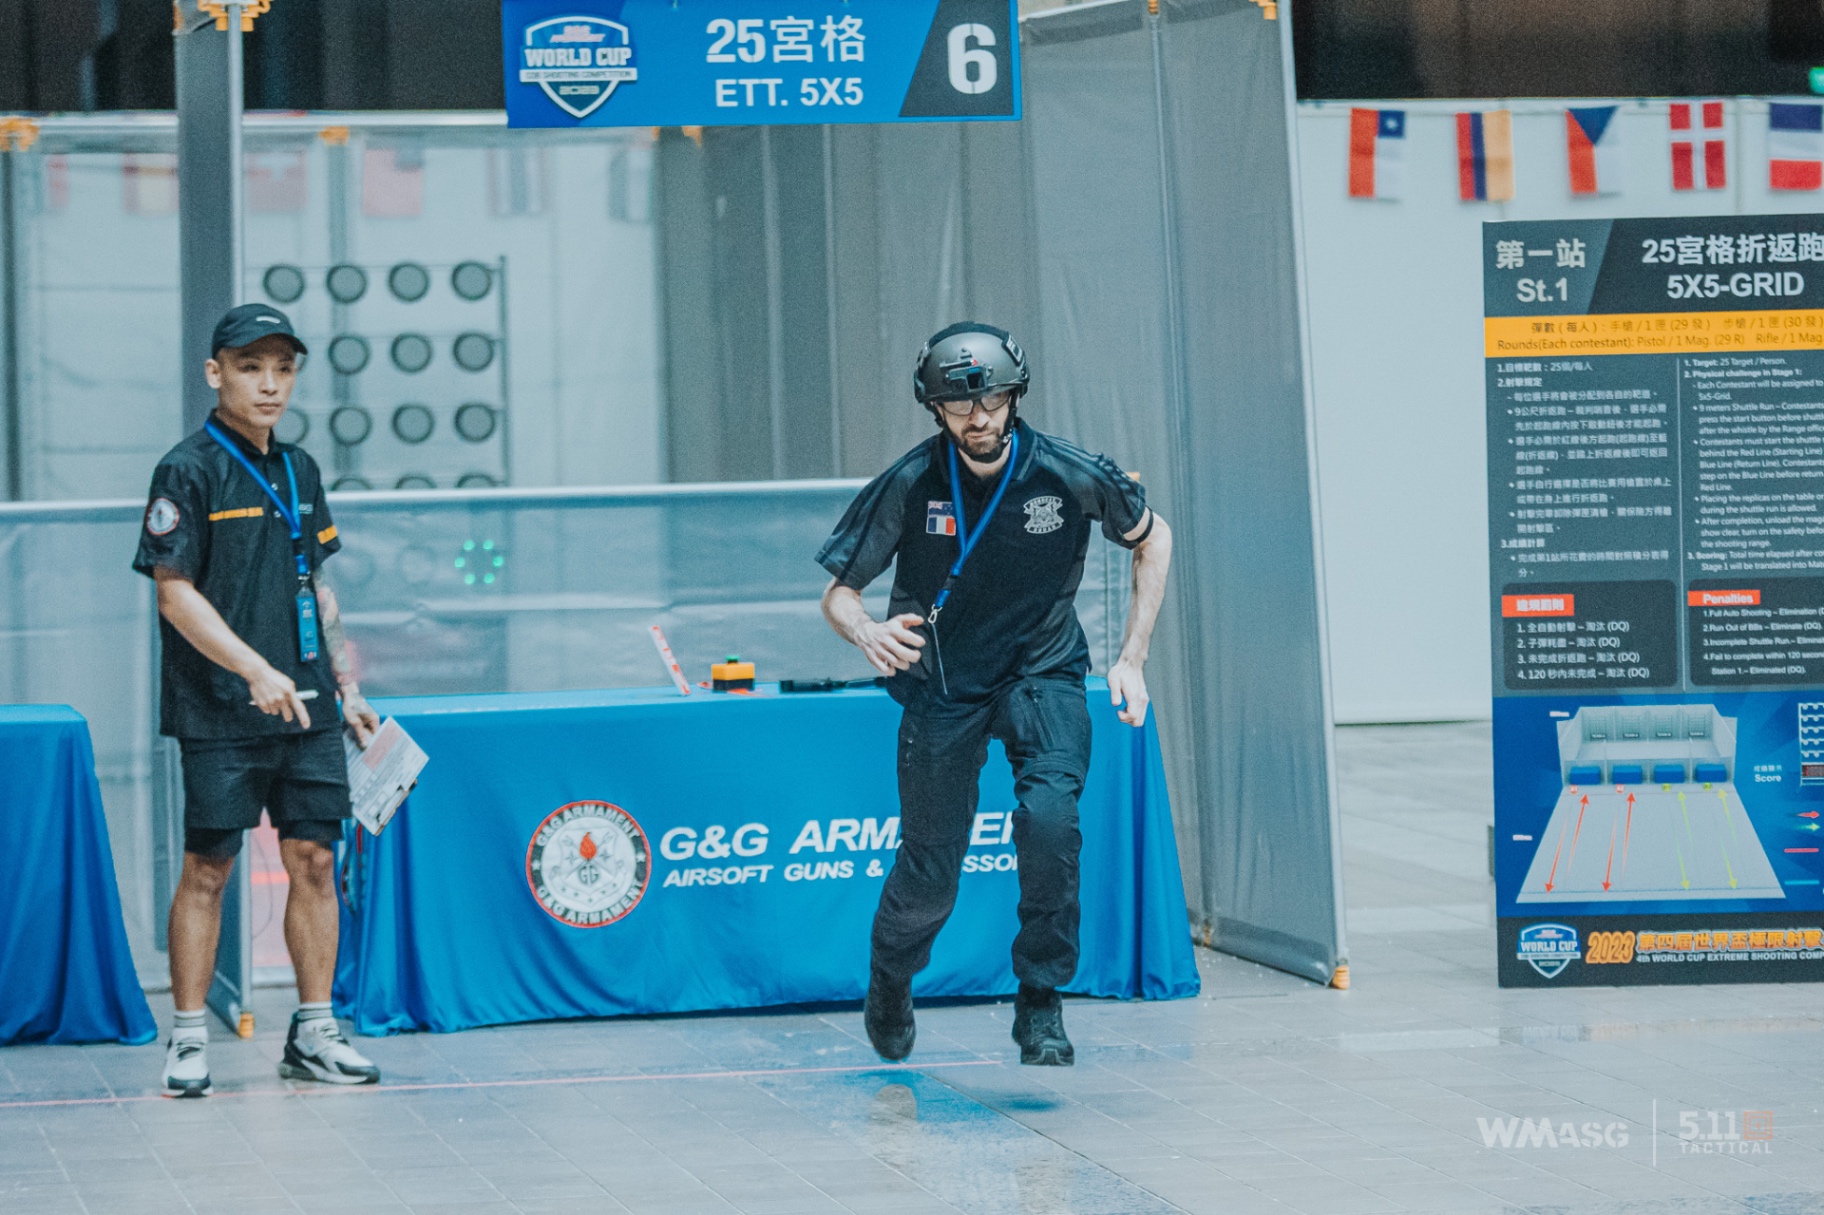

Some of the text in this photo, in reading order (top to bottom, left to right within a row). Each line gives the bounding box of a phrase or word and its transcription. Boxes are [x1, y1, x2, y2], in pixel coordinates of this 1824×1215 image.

[706, 16, 866, 64] 25宮格
[524, 47, 632, 67] WORLD CUP
[947, 23, 998, 95] 6
[716, 77, 864, 108] ETT. 5X5
[1496, 238, 1586, 270] 第一站
[1642, 232, 1824, 265] 25宮格折返跑
[1517, 278, 1568, 303] St.1
[1667, 271, 1805, 299] 5X5-GRID
[1637, 336, 1666, 347] Pistol
[1756, 333, 1779, 344] Rifle
[1703, 593, 1754, 604] Penalties
[1606, 621, 1629, 632] (DQ)
[1597, 636, 1620, 647] (DQ)
[1617, 651, 1639, 662] (DQ)
[1528, 669, 1546, 679] 120
[1627, 667, 1649, 678] (DQ)
[1755, 774, 1782, 782] Score
[563, 805, 640, 839] ARMAMENT
[660, 822, 770, 861] G&G
[662, 859, 884, 888] AIRSOFT GUNS &
[565, 878, 644, 924] ARMAMENT
[1521, 941, 1578, 952] WORLD CUP
[1585, 930, 1636, 964] 2023
[1636, 954, 1650, 963] 4th
[1652, 953, 1685, 963] WORLD
[1687, 953, 1705, 962] CUP
[1707, 952, 1749, 962] EXTREME
[1751, 952, 1797, 961] SHOOTING
